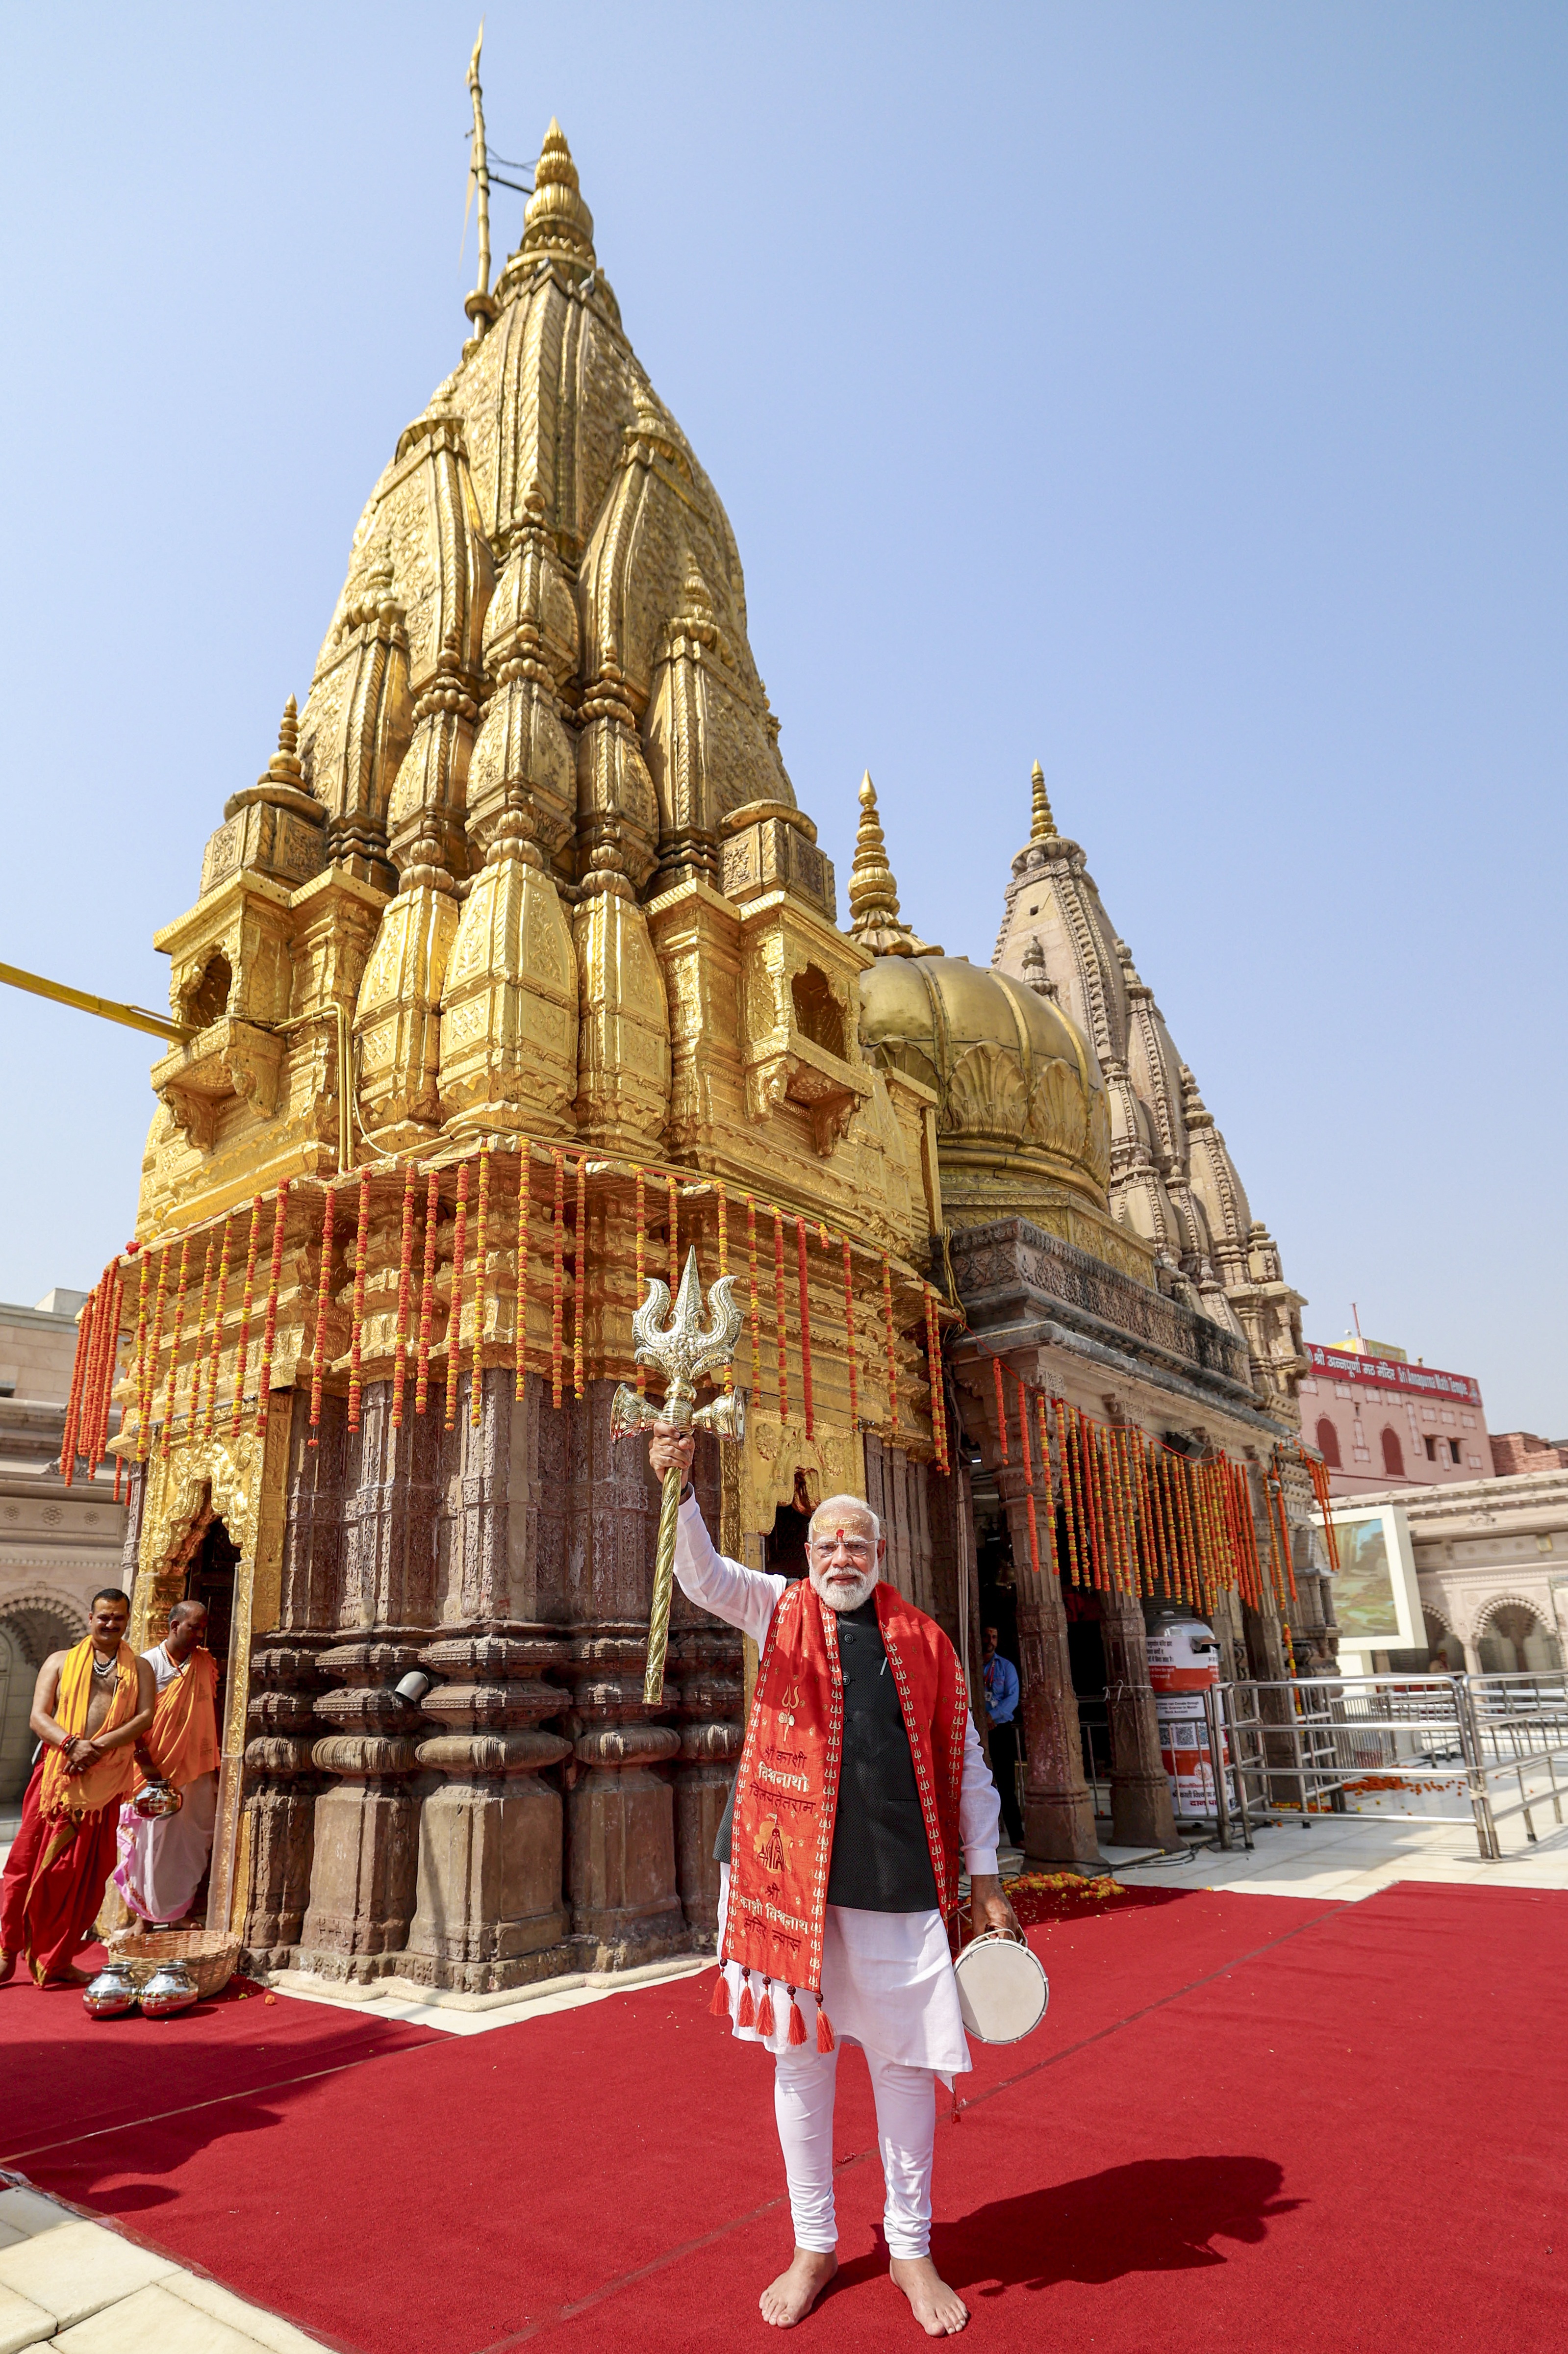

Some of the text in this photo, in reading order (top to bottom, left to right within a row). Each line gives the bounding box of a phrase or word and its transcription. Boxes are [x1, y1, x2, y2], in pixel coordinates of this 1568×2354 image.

[1314, 1348, 1396, 1381] श्री अन्नपूर्णा मठ मंदिर
[1397, 1366, 1468, 1397] Sri Annapurna Math Temple
[763, 1746, 807, 1768] श्री काशी
[765, 1882, 780, 1901] श्री
[740, 1894, 809, 1935] काशी विश्वनाथ
[772, 1930, 802, 1952] न्यास
